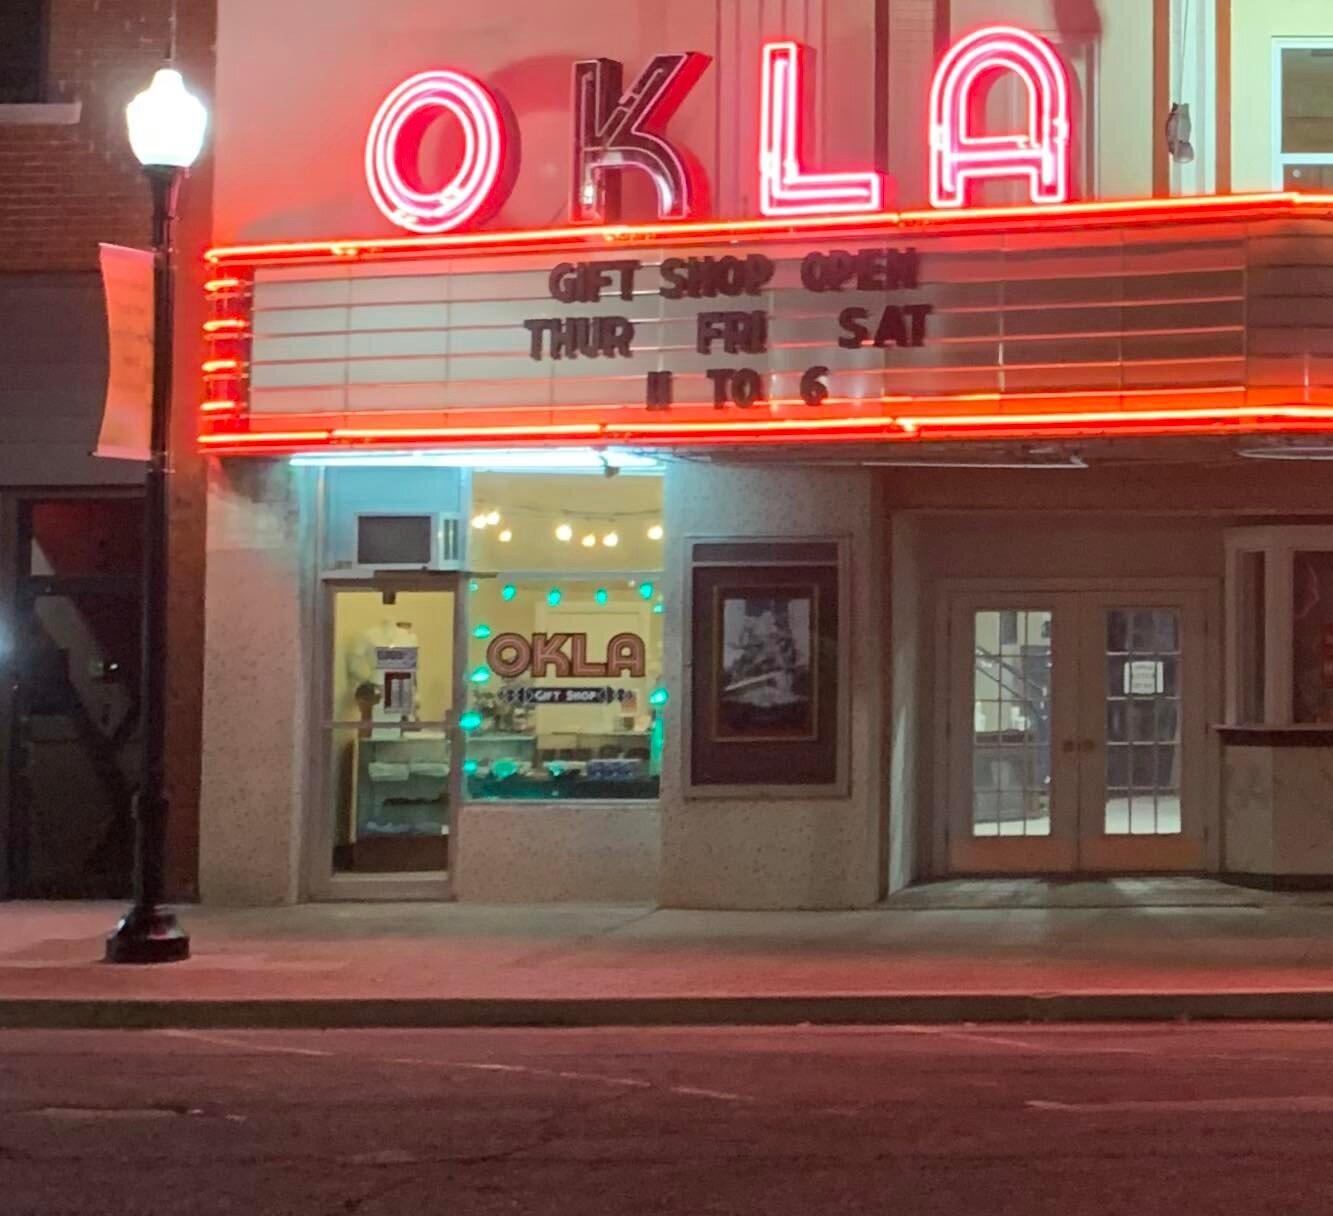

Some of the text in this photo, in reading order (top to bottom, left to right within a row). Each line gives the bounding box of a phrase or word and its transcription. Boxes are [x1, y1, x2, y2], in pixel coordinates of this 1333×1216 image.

[365, 25, 1073, 234] OKLA
[548, 247, 920, 303] GIFT SHOP OPEN
[523, 304, 934, 361] THUR FRI SAT
[706, 368, 762, 410] TO
[799, 365, 830, 407] 6
[486, 632, 646, 678] OKLA
[534, 689, 597, 702] GIFT SHOP
